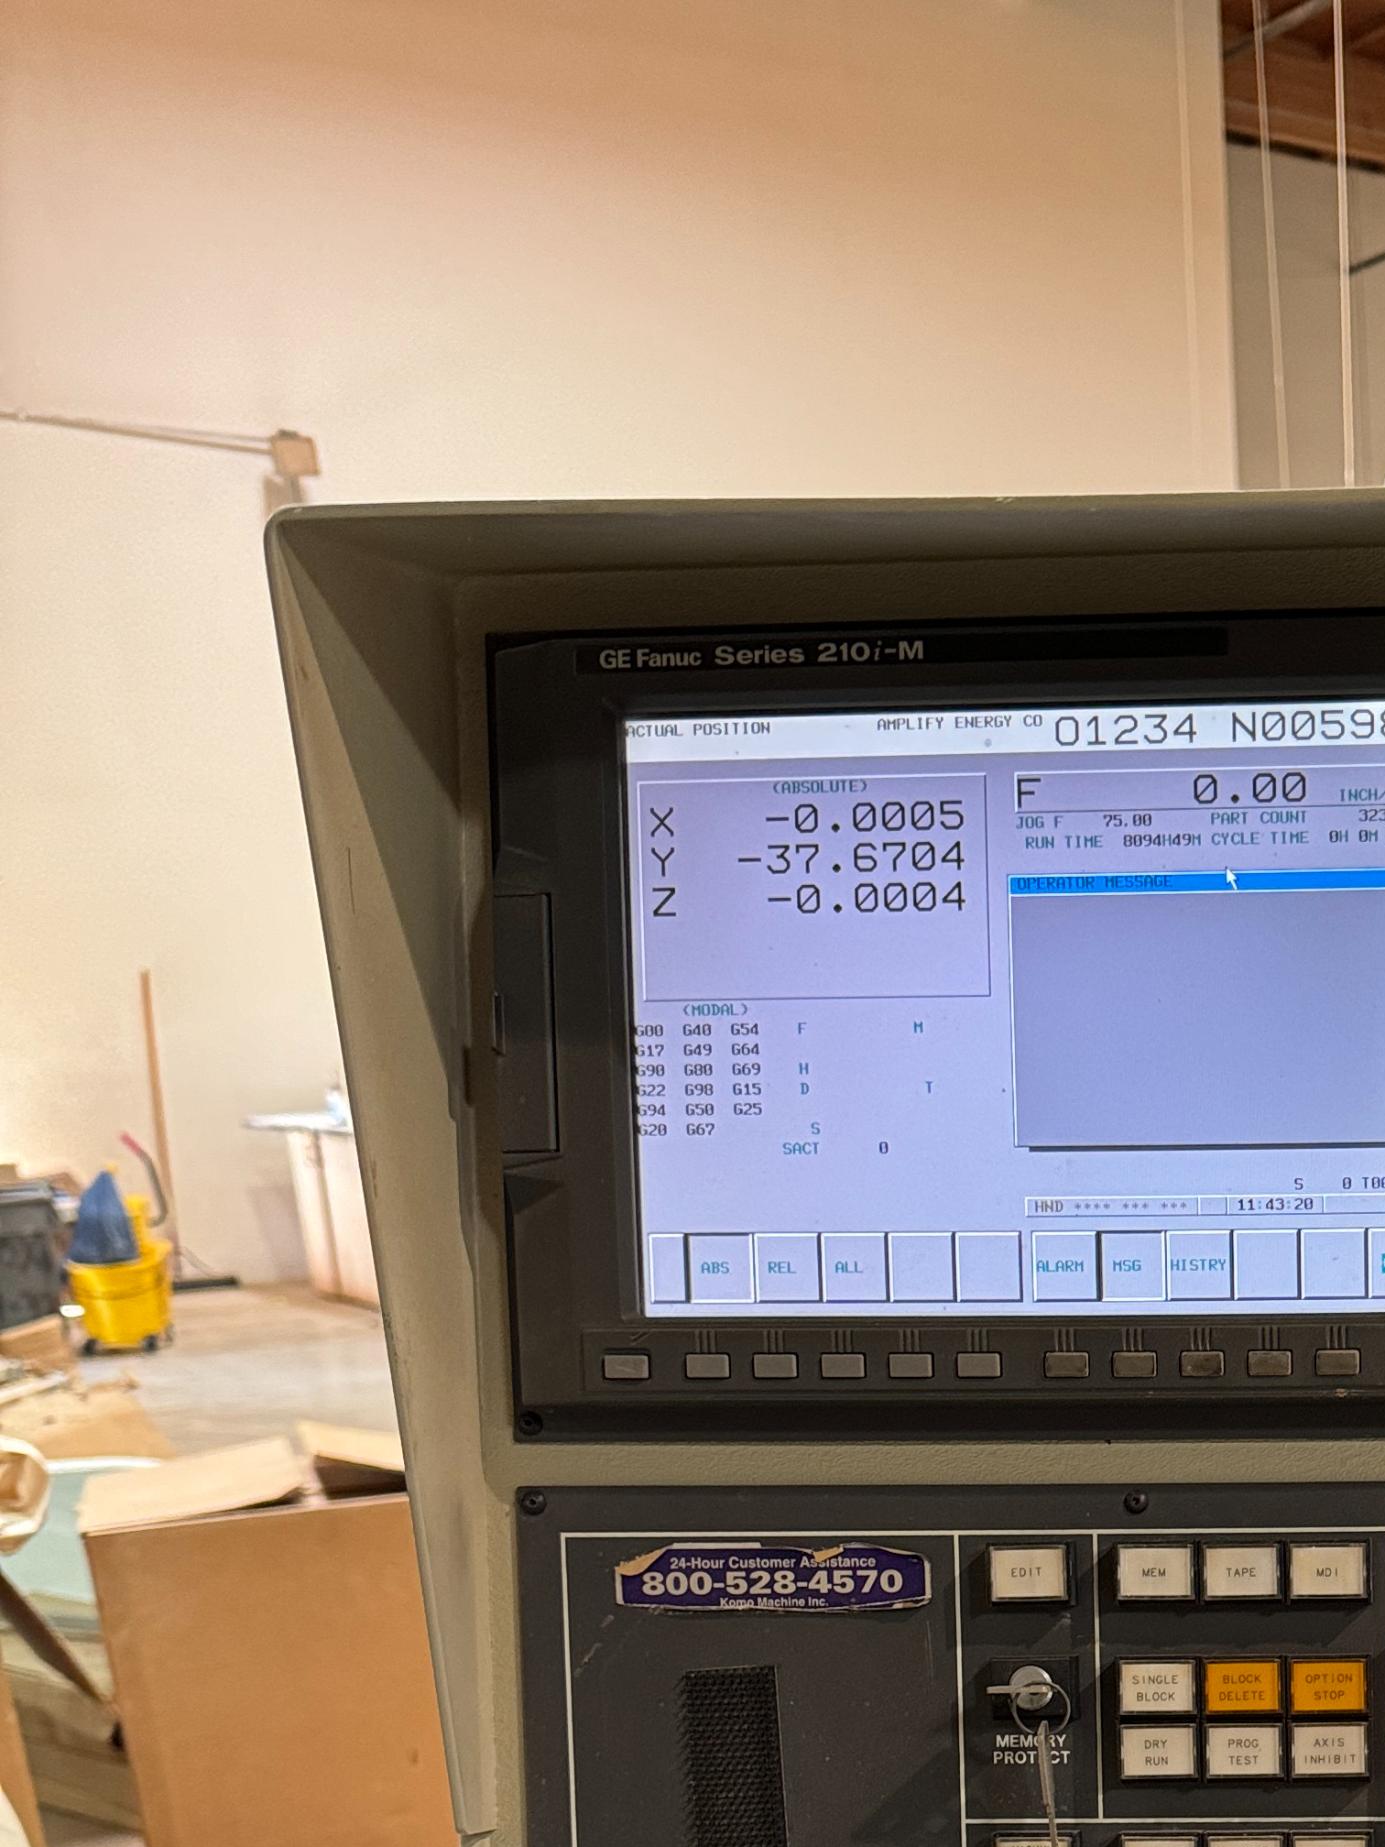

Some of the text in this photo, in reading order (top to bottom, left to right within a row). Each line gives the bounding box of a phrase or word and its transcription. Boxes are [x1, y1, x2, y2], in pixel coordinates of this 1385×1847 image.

[599, 640, 924, 669] GE Fanuc Series 210i-M
[876, 714, 1043, 731] AMPLIFY ENERGY CO
[627, 722, 771, 738] ACTUAL POSITION
[773, 779, 868, 795] (ABSOLUTE)
[1017, 777, 1042, 808] F
[1193, 771, 1307, 804] 0.00
[650, 800, 964, 837] X -0.0005
[1016, 813, 1152, 830] JOG F 75.00
[1210, 811, 1249, 825] PART
[1259, 810, 1307, 824] COUNT
[1025, 835, 1055, 850] RUN
[1064, 834, 1104, 849] TIME
[1211, 831, 1260, 846] CYCLE
[1270, 830, 1309, 845] TIME
[651, 840, 965, 877] Y -37.6704
[1017, 874, 1173, 891] OPERATOR MESSAGE
[652, 880, 966, 917] Z -0.0004
[682, 1003, 748, 1017] (MODAL)
[1237, 1197, 1314, 1212] 11:43:20
[700, 1261, 730, 1274] ABS
[767, 1261, 796, 1274] REL
[834, 1260, 864, 1274] ALL
[1035, 1259, 1084, 1273] ALARM
[1113, 1259, 1142, 1272] MSG
[1170, 1258, 1227, 1272] HISTRY
[670, 1555, 876, 1570] 24-Hour Customer Assistance
[1011, 1567, 1042, 1578] EDIT
[1142, 1567, 1167, 1578] MEM
[1226, 1567, 1257, 1578] TAPE
[1316, 1567, 1339, 1578] MDI
[642, 1569, 903, 1596] 800-528-4570
[720, 1596, 829, 1608] Komo Machine Inc.
[1132, 1674, 1178, 1686] SINGLE
[1222, 1673, 1262, 1685] BLOCK
[1305, 1673, 1353, 1684] OPTION
[1136, 1691, 1176, 1703] BLOCK
[1218, 1690, 1265, 1702] DELETE
[1313, 1690, 1345, 1701] STOP
[1144, 1739, 1167, 1751] DRY
[1228, 1738, 1259, 1750] PROG
[1314, 1737, 1345, 1748] AXIS
[993, 1751, 1071, 1766] PROTCT
[1145, 1755, 1169, 1767] RUN
[1228, 1754, 1259, 1766] TEST
[1304, 1754, 1357, 1766] INHIBIT
